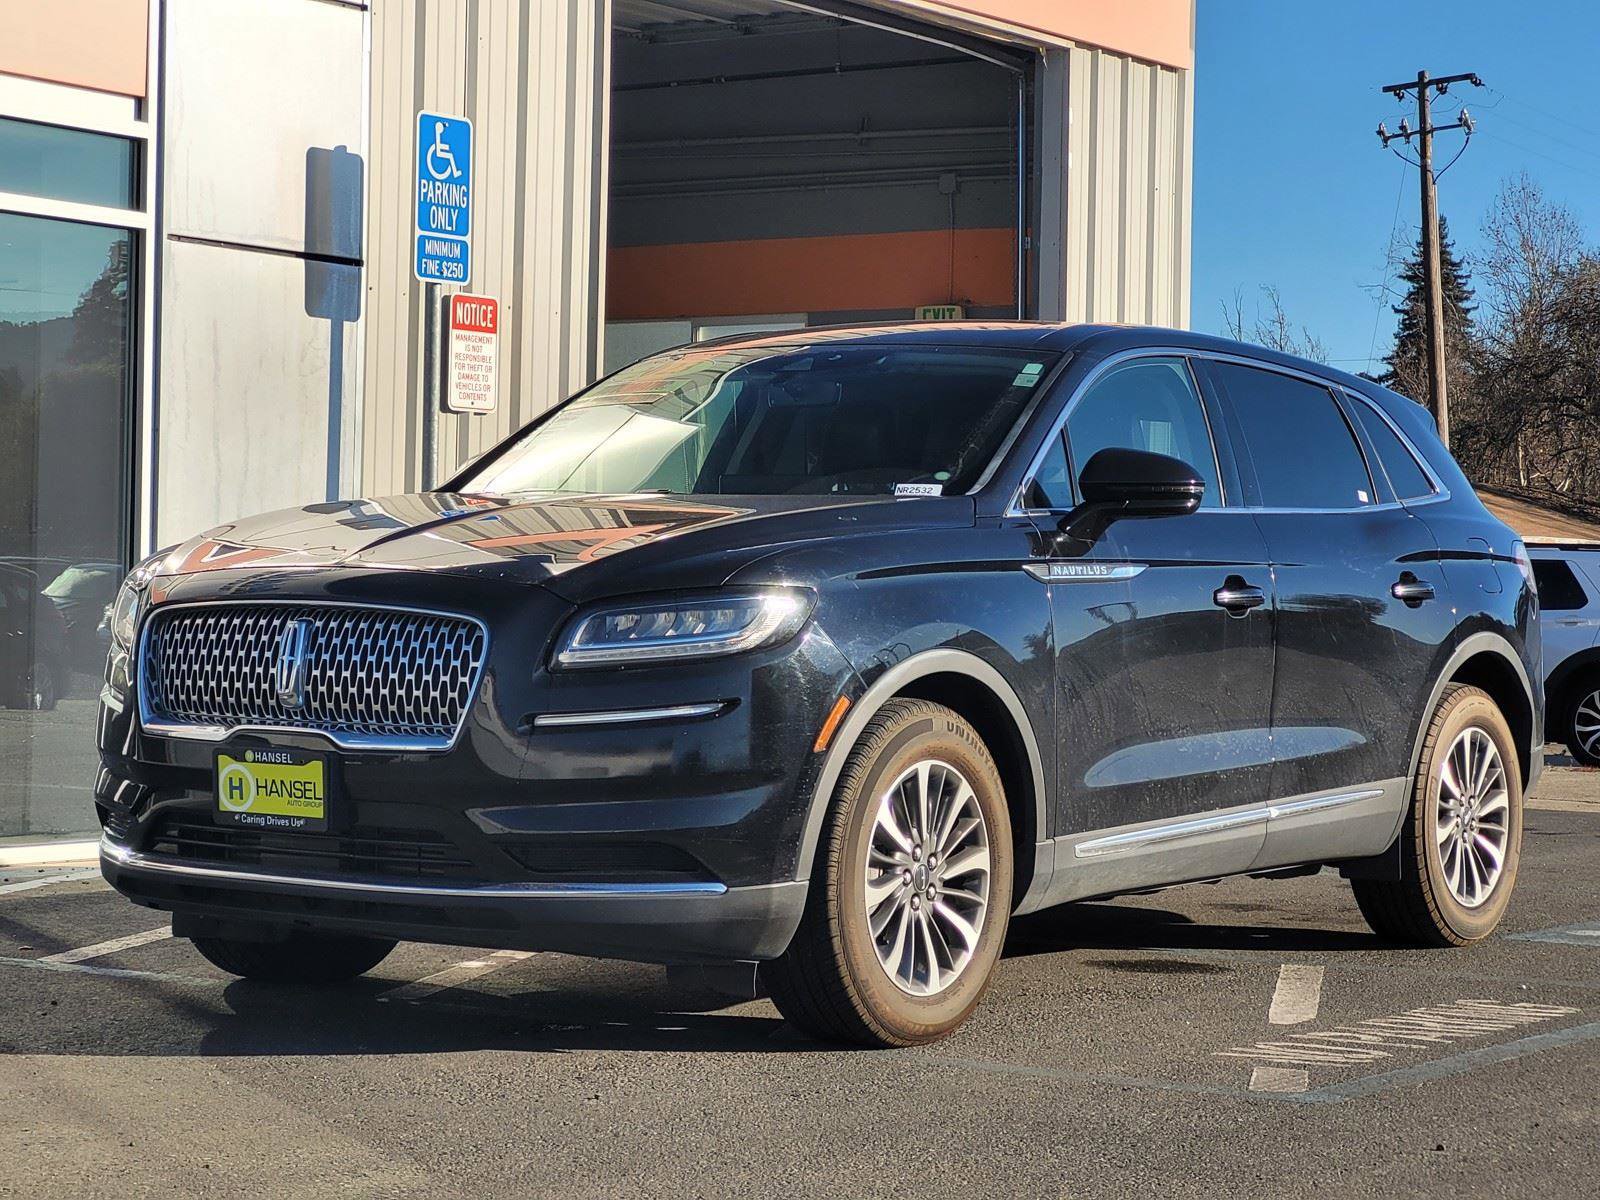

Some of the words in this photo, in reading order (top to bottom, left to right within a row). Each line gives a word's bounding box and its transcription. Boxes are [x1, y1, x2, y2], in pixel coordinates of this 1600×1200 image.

[420, 179, 467, 208] PARKING
[430, 207, 459, 231] ONLY
[425, 239, 460, 259] MINIMUM
[422, 259, 440, 276] FINE
[442, 260, 464, 279] $250
[456, 302, 494, 328] NOTICE
[455, 333, 493, 345] MANAGEMENT
[472, 345, 483, 353] NOT
[455, 353, 492, 364] RESPONSIBLE
[455, 362, 466, 371] FOR
[467, 363, 483, 373] THEFT
[484, 365, 492, 373] OR
[458, 372, 480, 382] DAMAGE
[482, 374, 489, 382] TO
[456, 382, 482, 392] VEHICLES
[483, 384, 491, 392] OR
[459, 391, 487, 402] CONTENTS
[896, 486, 934, 494] NR2532
[1053, 565, 1107, 576] NAUTILUS
[255, 751, 293, 764] HANSEL
[228, 777, 244, 800] H
[256, 778, 323, 801] HANSEL
[303, 800, 323, 809] GROUP
[241, 813, 265, 826] Caring
[267, 815, 290, 827] Drives
